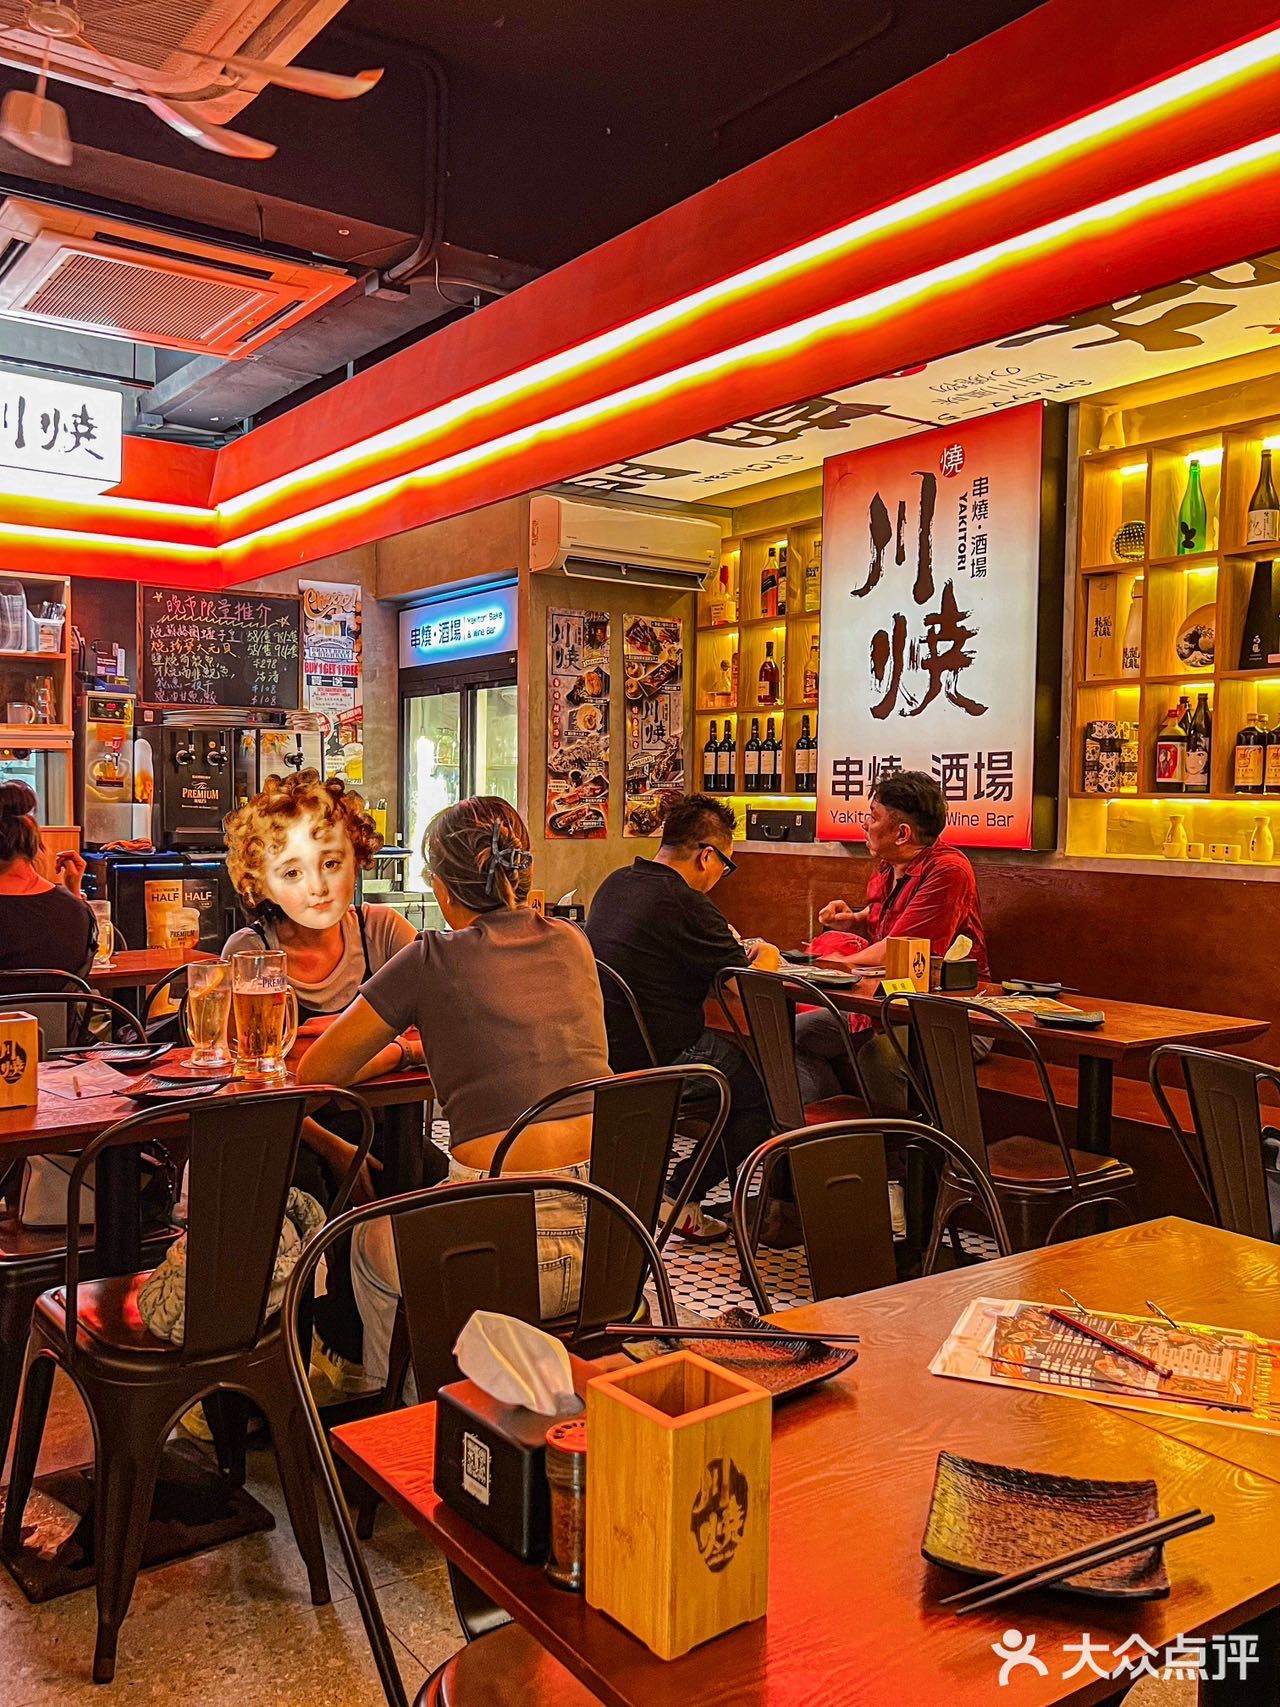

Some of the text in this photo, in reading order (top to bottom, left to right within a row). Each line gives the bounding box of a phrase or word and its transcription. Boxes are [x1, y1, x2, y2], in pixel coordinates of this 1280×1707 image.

[940, 443, 964, 477] 燒
[957, 492, 968, 571] YAKITORI
[304, 662, 317, 674] BUY
[323, 663, 337, 675] GET
[341, 664, 359, 676] FREE
[930, 751, 1013, 801] 酒場
[182, 787, 219, 800] PREMIUM
[946, 811, 980, 826] Wine
[987, 812, 1014, 827] Bar
[151, 892, 179, 902] HALF
[184, 891, 213, 901] HALF
